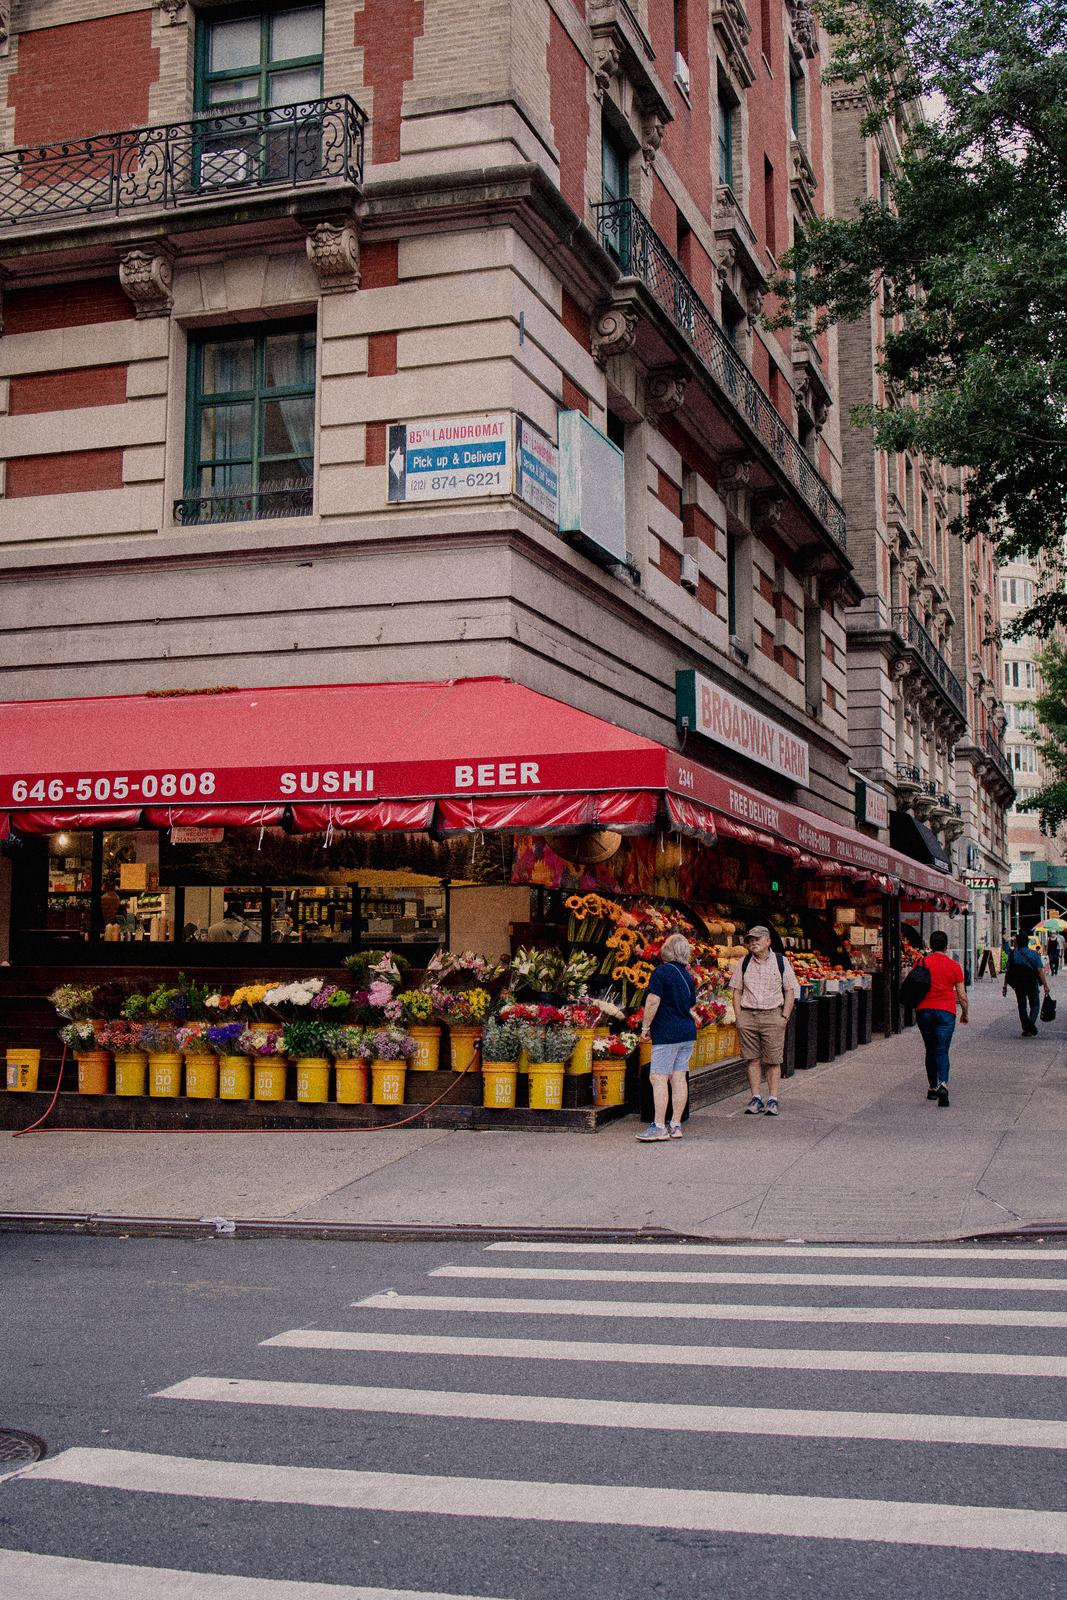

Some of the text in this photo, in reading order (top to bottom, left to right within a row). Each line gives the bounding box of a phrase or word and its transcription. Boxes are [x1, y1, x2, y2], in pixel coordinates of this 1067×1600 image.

[432, 422, 504, 442] LAUNDROMAT
[413, 451, 502, 469] Pick up & Delivery
[411, 472, 501, 491] (212) 874-6221
[701, 685, 806, 780] BROADWAY FARM
[12, 771, 216, 802] 646-505-0808
[279, 769, 374, 794] SUSHI
[454, 761, 541, 788] BEER
[678, 767, 694, 790] 2341
[729, 788, 780, 830] FREE DELIVERY
[965, 878, 996, 889] PIZZA
